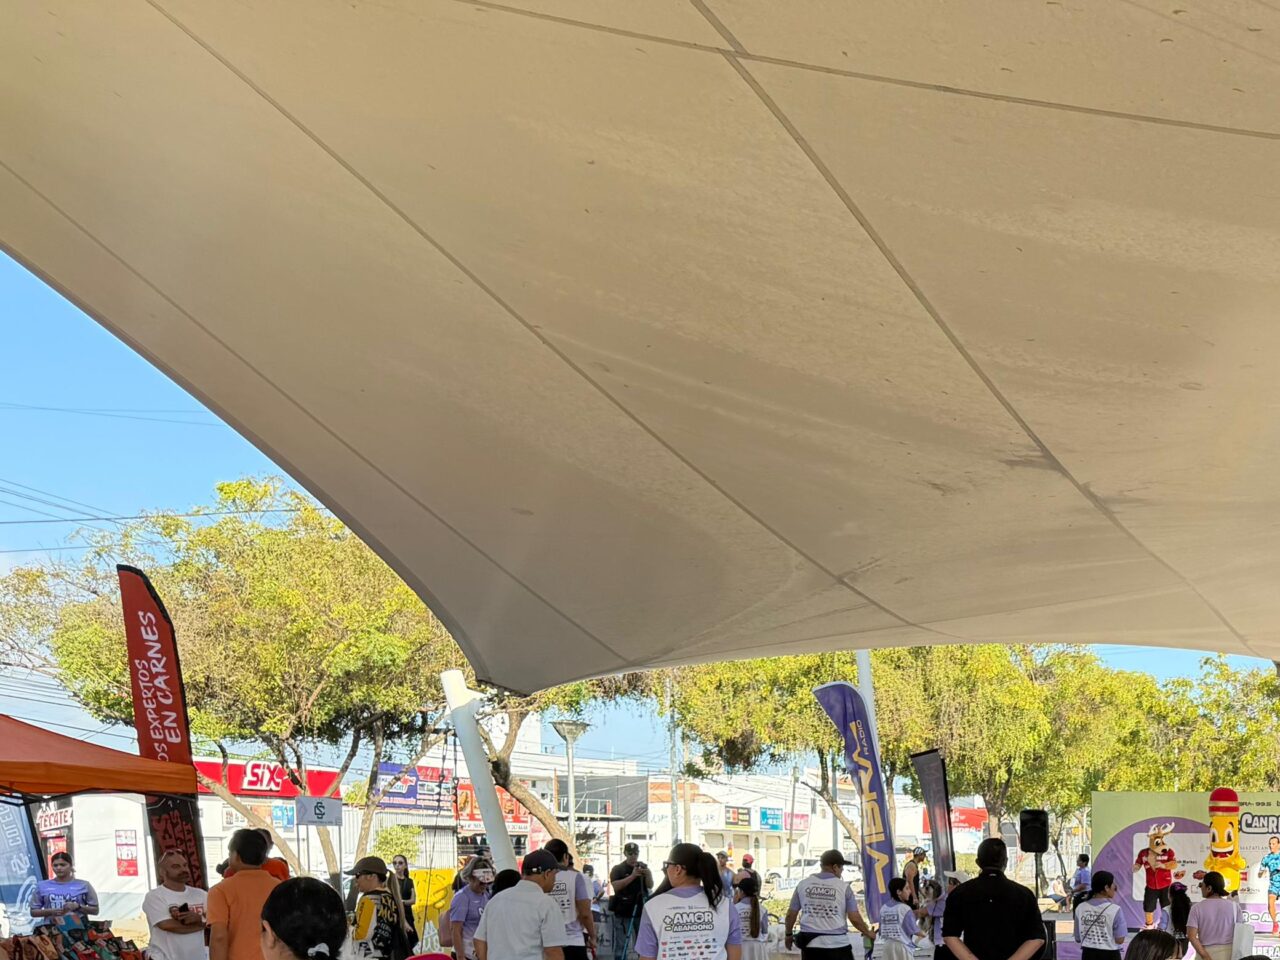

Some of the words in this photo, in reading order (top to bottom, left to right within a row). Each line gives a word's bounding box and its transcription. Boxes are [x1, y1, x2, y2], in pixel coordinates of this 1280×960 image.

[137, 611, 174, 705] CARNES
[134, 659, 165, 740] EXPERTOS
[160, 711, 182, 744] EN
[673, 911, 713, 924] AMOR
